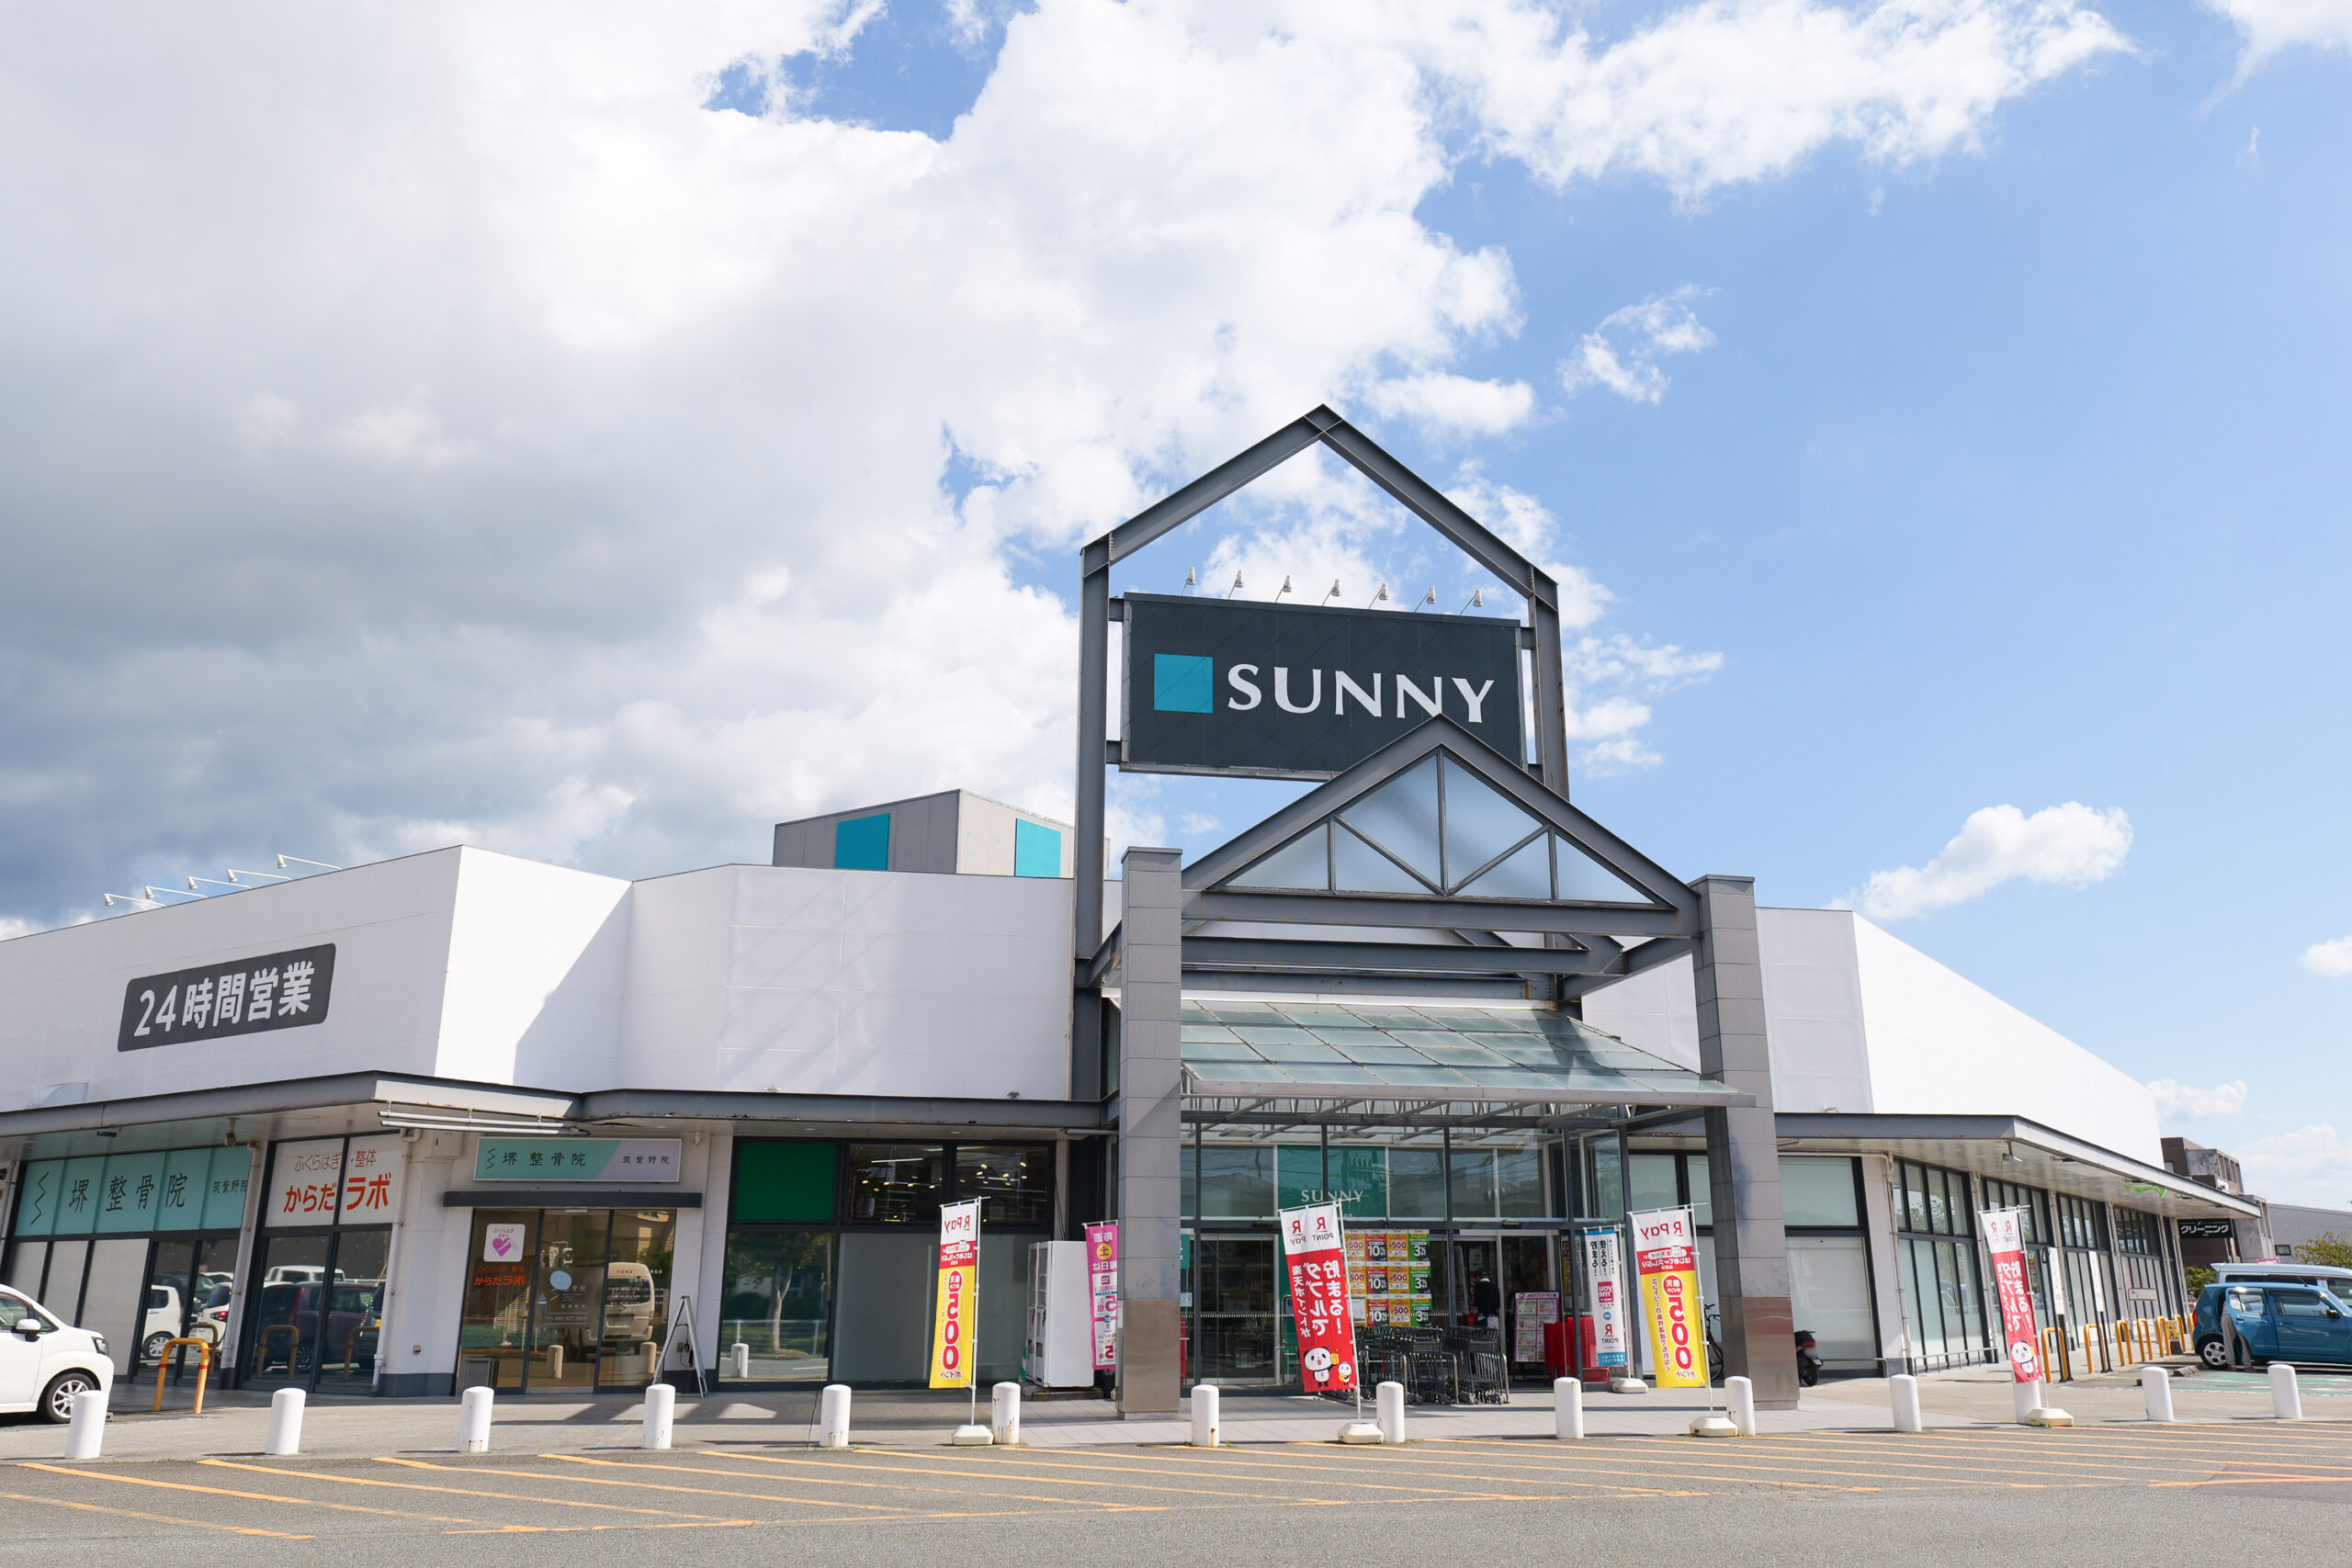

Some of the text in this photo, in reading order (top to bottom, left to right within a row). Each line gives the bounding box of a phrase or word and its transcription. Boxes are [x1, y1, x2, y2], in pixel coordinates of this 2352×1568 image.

[1227, 663, 1495, 723] SUNNY
[134, 960, 314, 1037] 24時間営業
[502, 1151, 586, 1167] 堺整骨院
[68, 1172, 188, 1213] 堺整骨院
[283, 1171, 391, 1213] からだラボ
[2180, 1224, 2229, 1234] クリーニング
